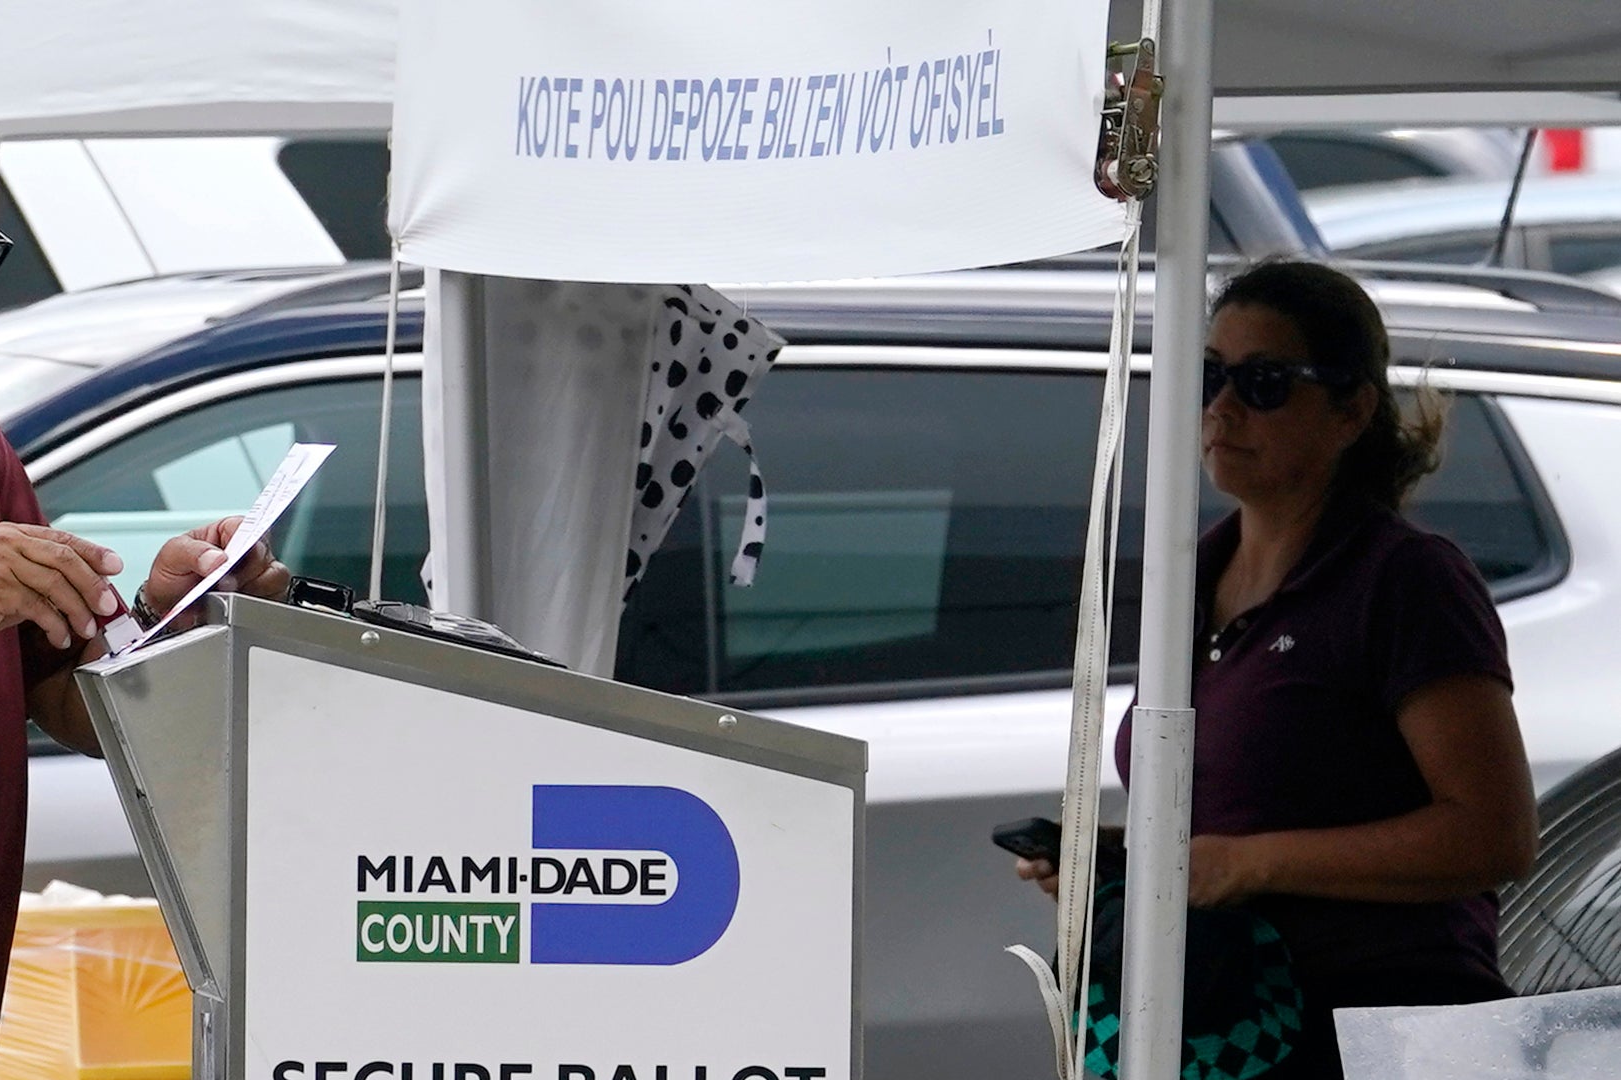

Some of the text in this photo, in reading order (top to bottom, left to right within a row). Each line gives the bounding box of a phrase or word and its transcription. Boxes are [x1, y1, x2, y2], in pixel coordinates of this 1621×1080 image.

[516, 76, 582, 158] KOTE
[587, 78, 644, 161] POU
[649, 78, 759, 161] DEPOZE
[757, 73, 856, 160] BILTEN
[360, 913, 516, 954] COUNTY
